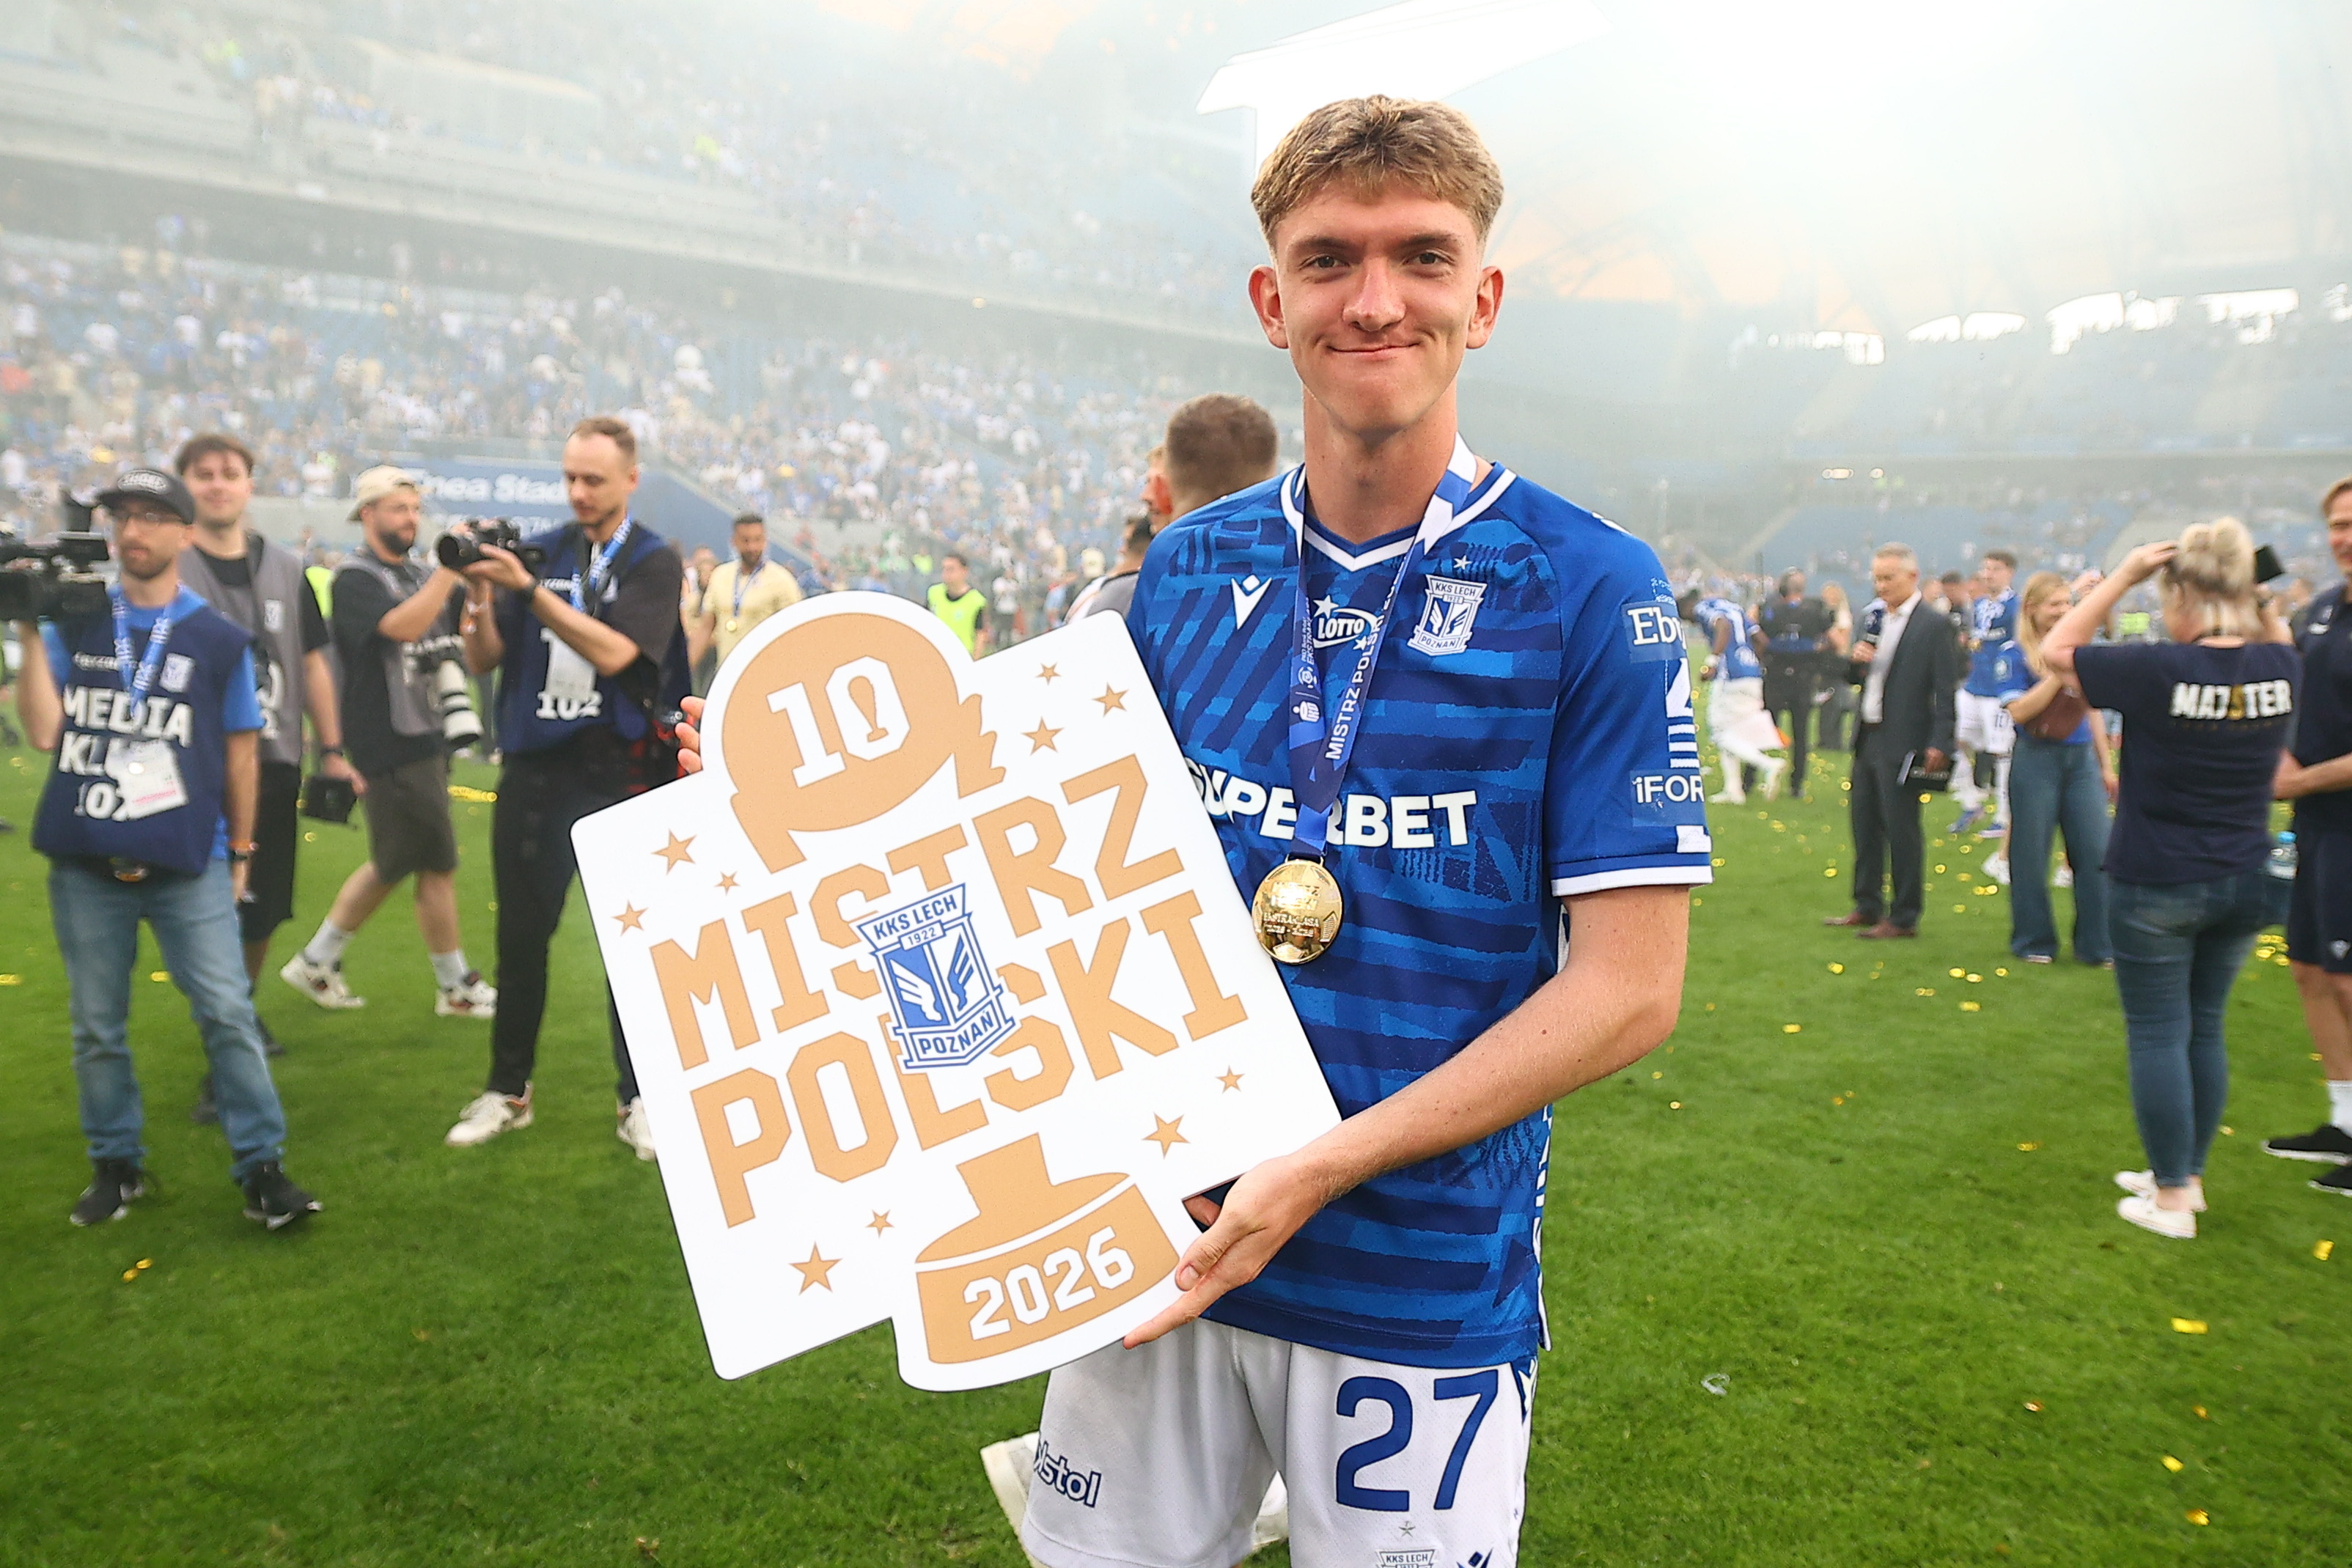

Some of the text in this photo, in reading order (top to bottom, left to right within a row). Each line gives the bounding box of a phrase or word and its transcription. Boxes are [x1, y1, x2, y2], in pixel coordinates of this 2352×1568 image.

[1435, 582, 1477, 597] KKS LECH
[1318, 617, 1365, 640] LOTTO
[63, 683, 194, 748] MEDIA
[1325, 614, 1384, 760] MISTRZ POLSKI
[766, 655, 911, 789] 10
[649, 754, 1185, 1071] MISTRZ
[872, 894, 958, 941] KKS LECH
[908, 927, 938, 946] 1922
[690, 889, 1249, 1229] POLSKI
[918, 1009, 994, 1055] POZNAŃ
[963, 1226, 1134, 1341] 2026
[1335, 1369, 1499, 1512] 27
[1386, 1553, 1428, 1563] KKS LECH
